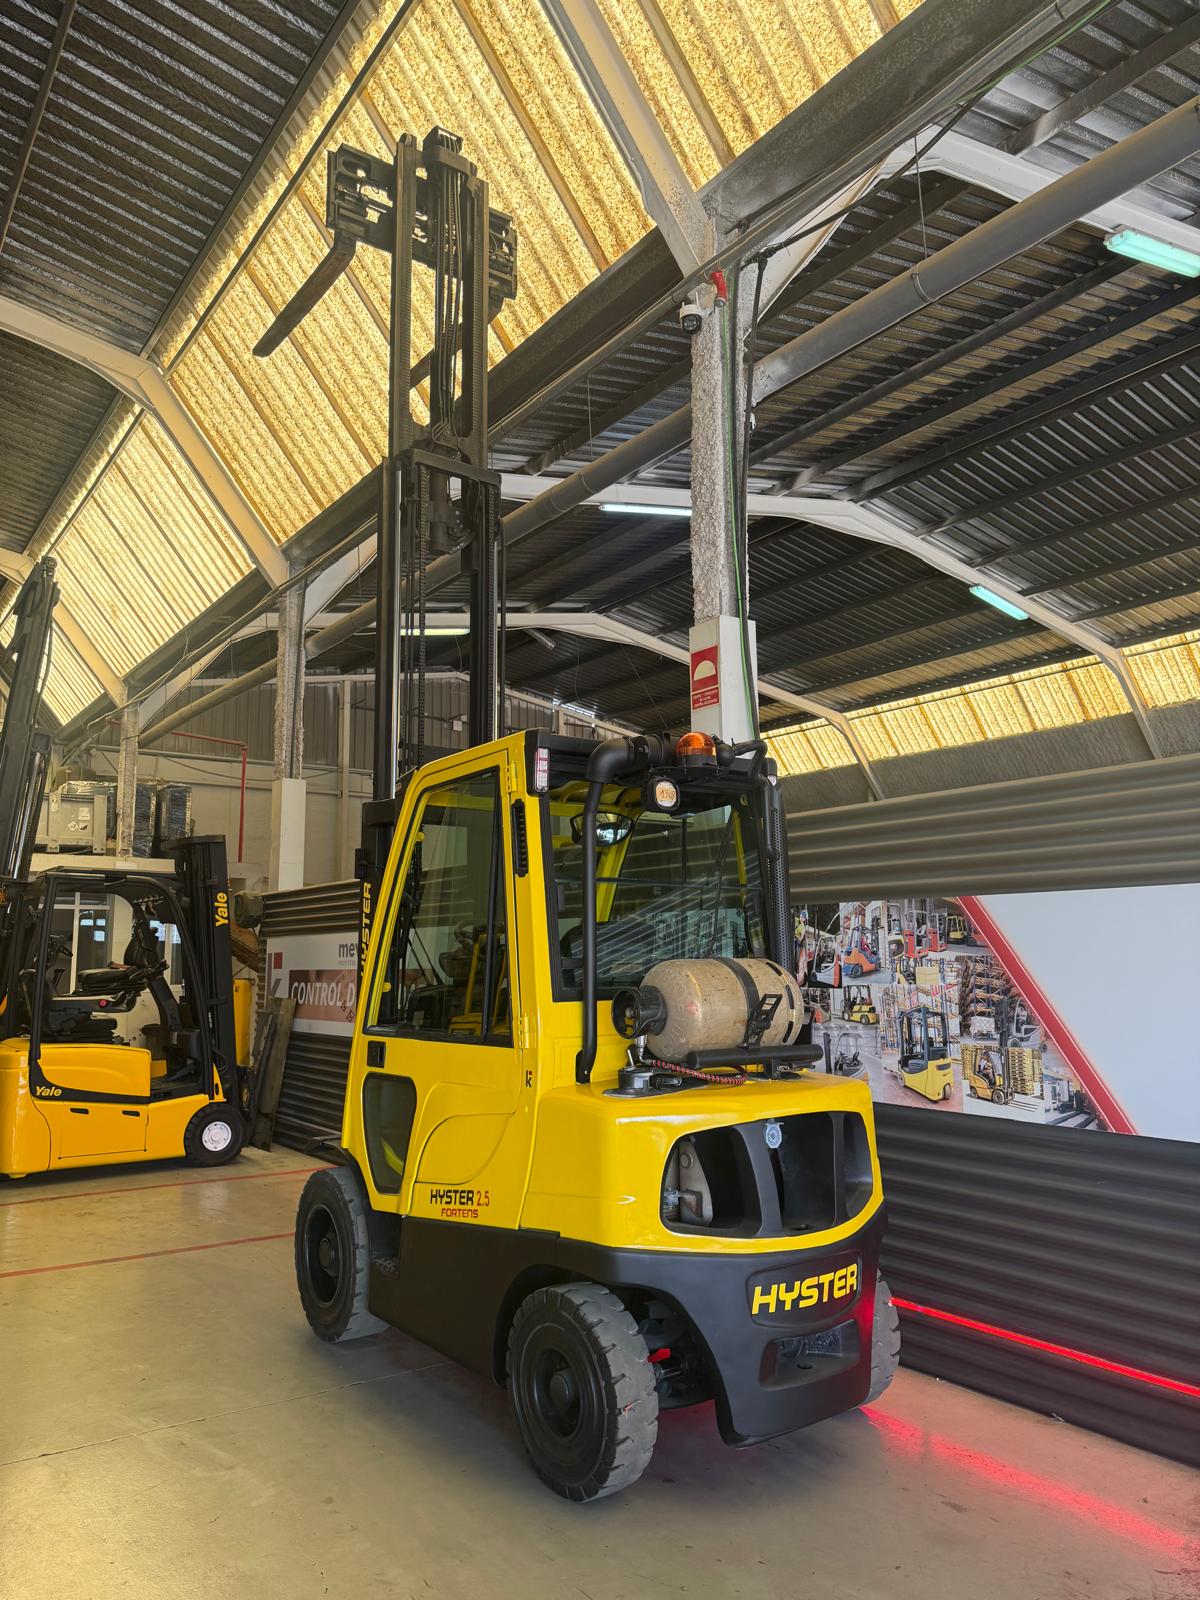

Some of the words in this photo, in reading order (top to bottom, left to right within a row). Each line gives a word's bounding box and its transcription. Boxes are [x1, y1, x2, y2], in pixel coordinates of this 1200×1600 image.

[214, 892, 228, 927] Yale
[291, 982, 344, 1007] CONTROL
[36, 1086, 62, 1096] Yale
[430, 1189, 474, 1206] HYSTER
[476, 1190, 490, 1207] 2.5
[441, 1208, 479, 1219] FORTENS
[751, 1263, 858, 1315] HYSTER
